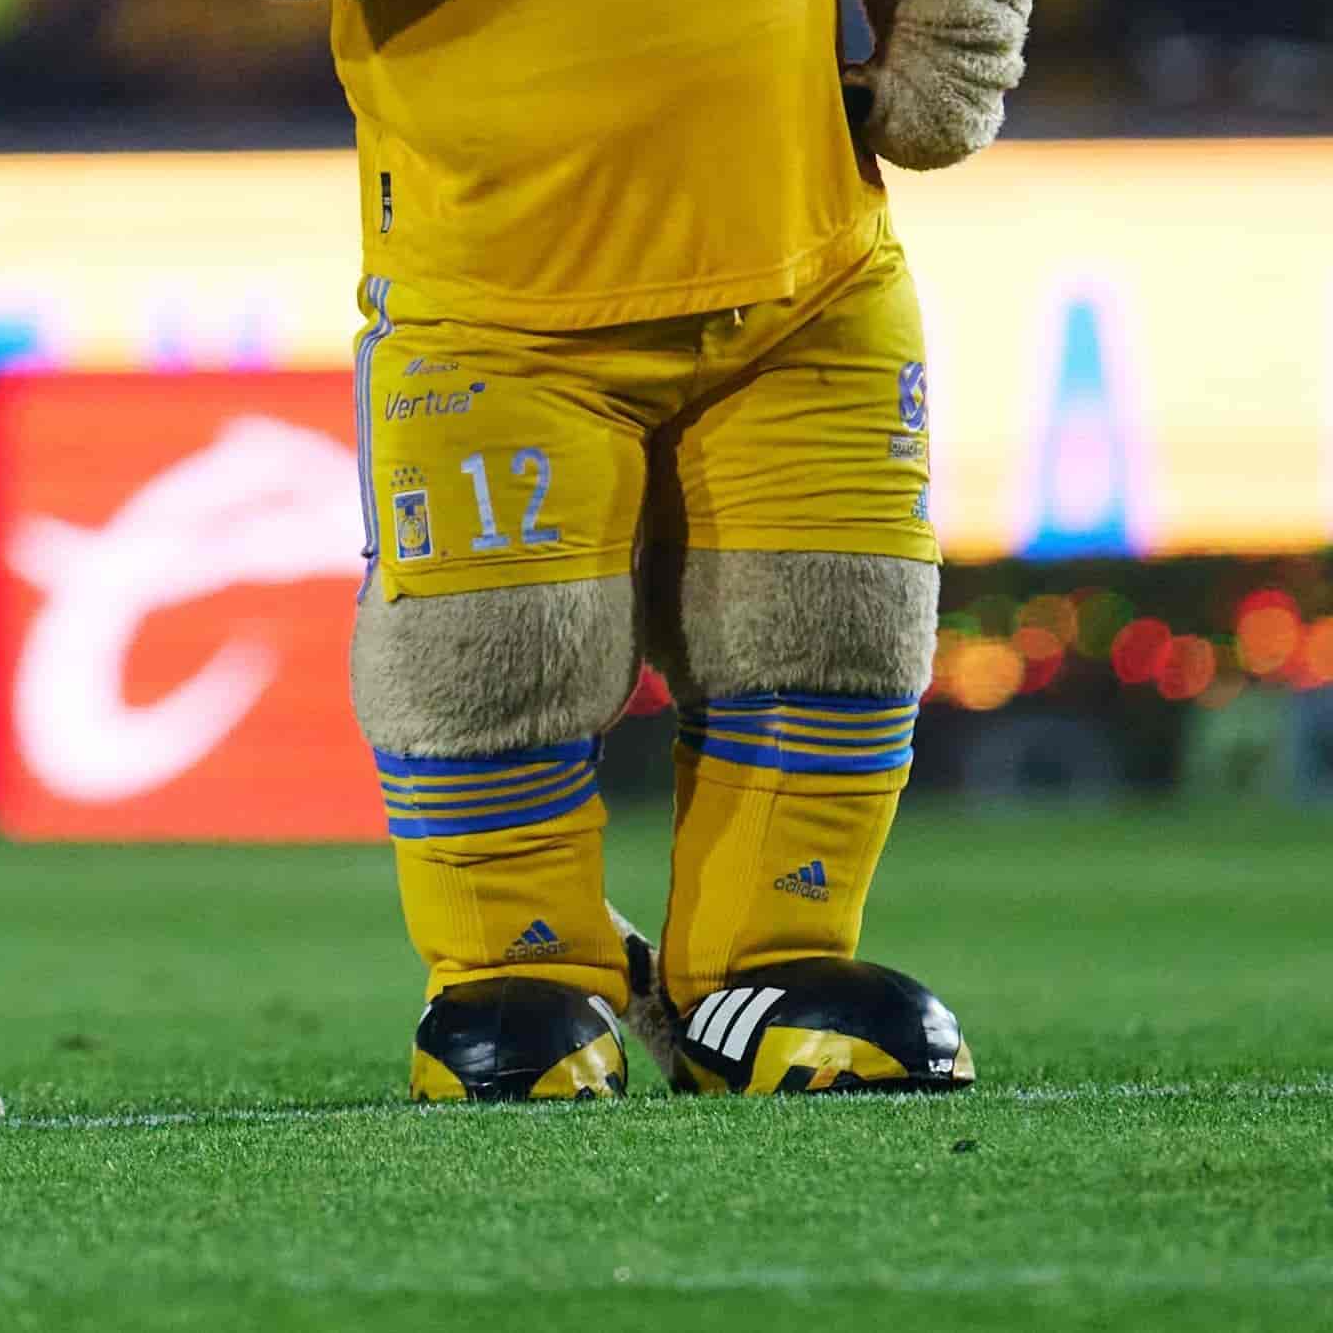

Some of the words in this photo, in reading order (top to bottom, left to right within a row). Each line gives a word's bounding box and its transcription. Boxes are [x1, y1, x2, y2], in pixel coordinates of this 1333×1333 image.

[384, 388, 473, 421] Vertua
[460, 446, 562, 551] 12
[773, 875, 830, 903] adidas
[505, 941, 568, 960] adidas
